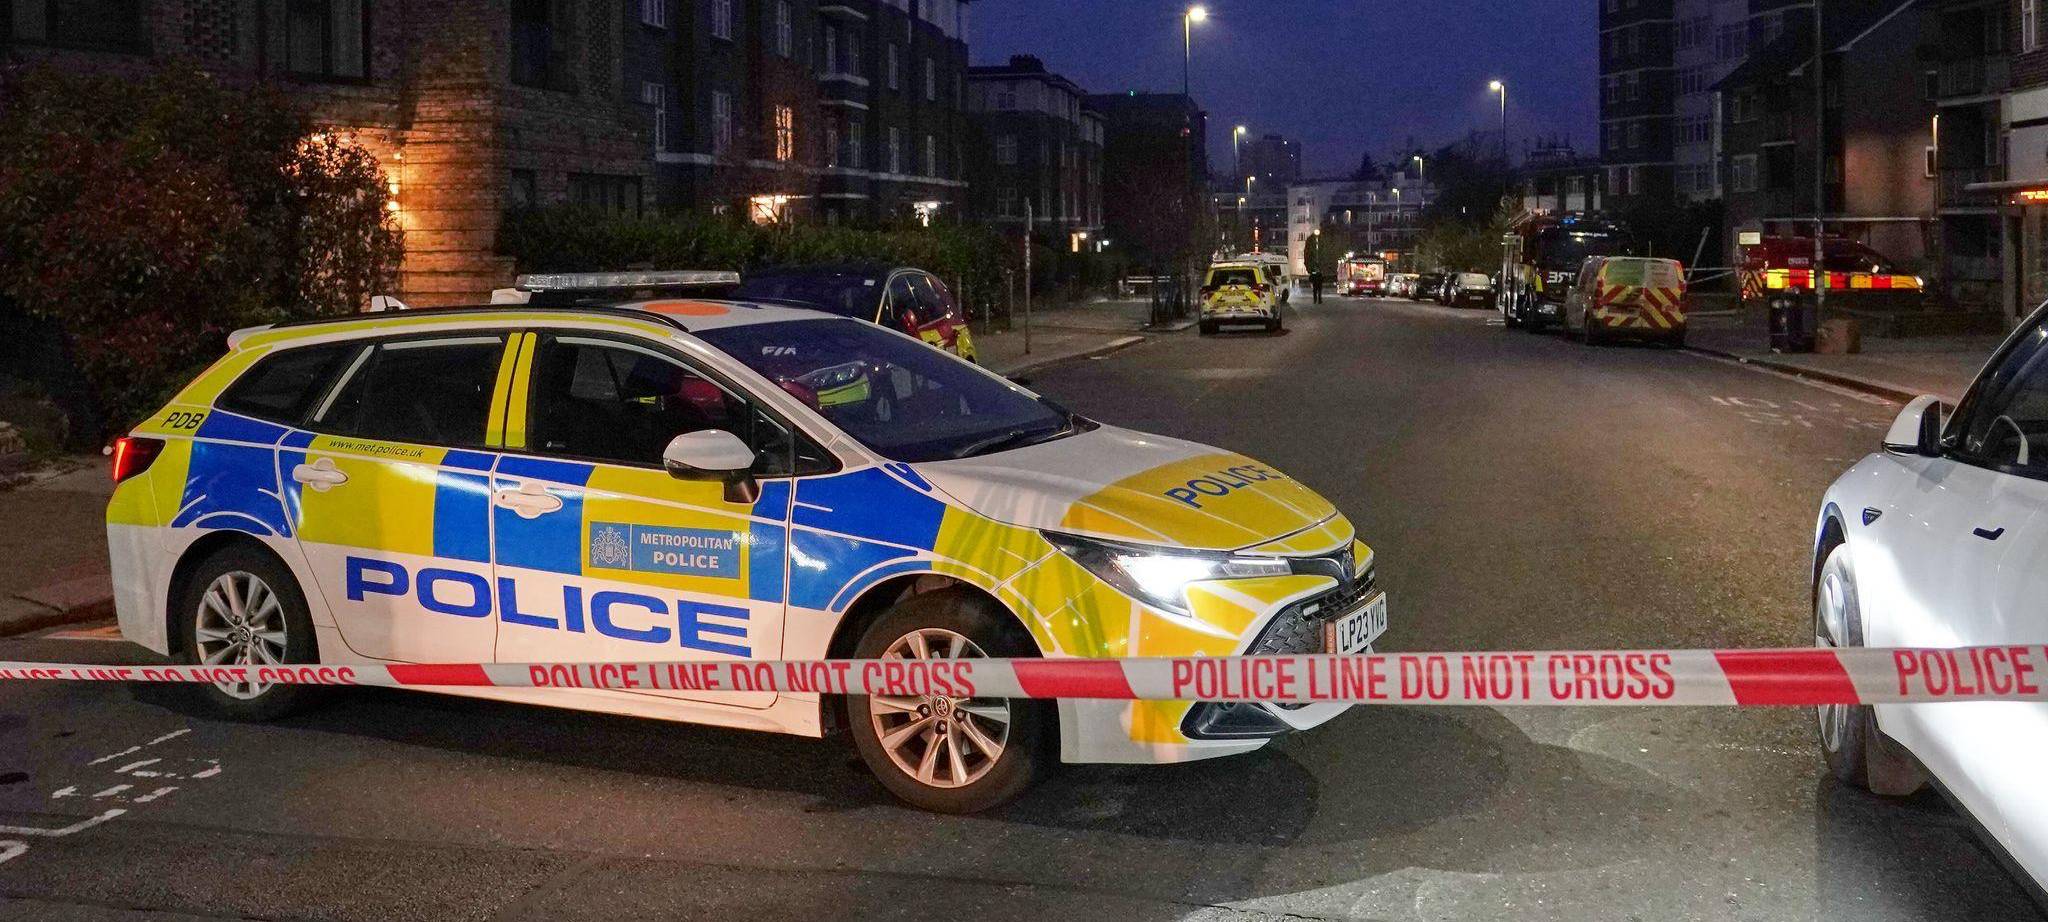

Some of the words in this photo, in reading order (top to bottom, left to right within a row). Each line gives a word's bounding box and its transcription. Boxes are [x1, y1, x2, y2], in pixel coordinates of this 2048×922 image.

[160, 411, 205, 430] PDB
[329, 440, 424, 458] www.met.police.uk
[1164, 464, 1282, 509] POLICE
[640, 532, 733, 550] METROPOLITAN
[653, 551, 719, 569] POLICE
[346, 555, 752, 658] POLICE
[1341, 611, 1369, 651] LP23
[529, 664, 640, 689] POLICE
[650, 663, 720, 691] LINE
[730, 662, 779, 692] DO
[786, 662, 850, 694] NOT
[862, 660, 977, 697] CROSS
[1172, 658, 1297, 700] POLICE
[1309, 656, 1388, 700] LINE
[1401, 656, 1450, 700] DO
[1463, 655, 1536, 700] NOT
[1548, 653, 1676, 700] CROSS
[1894, 646, 2039, 697] POLICE
